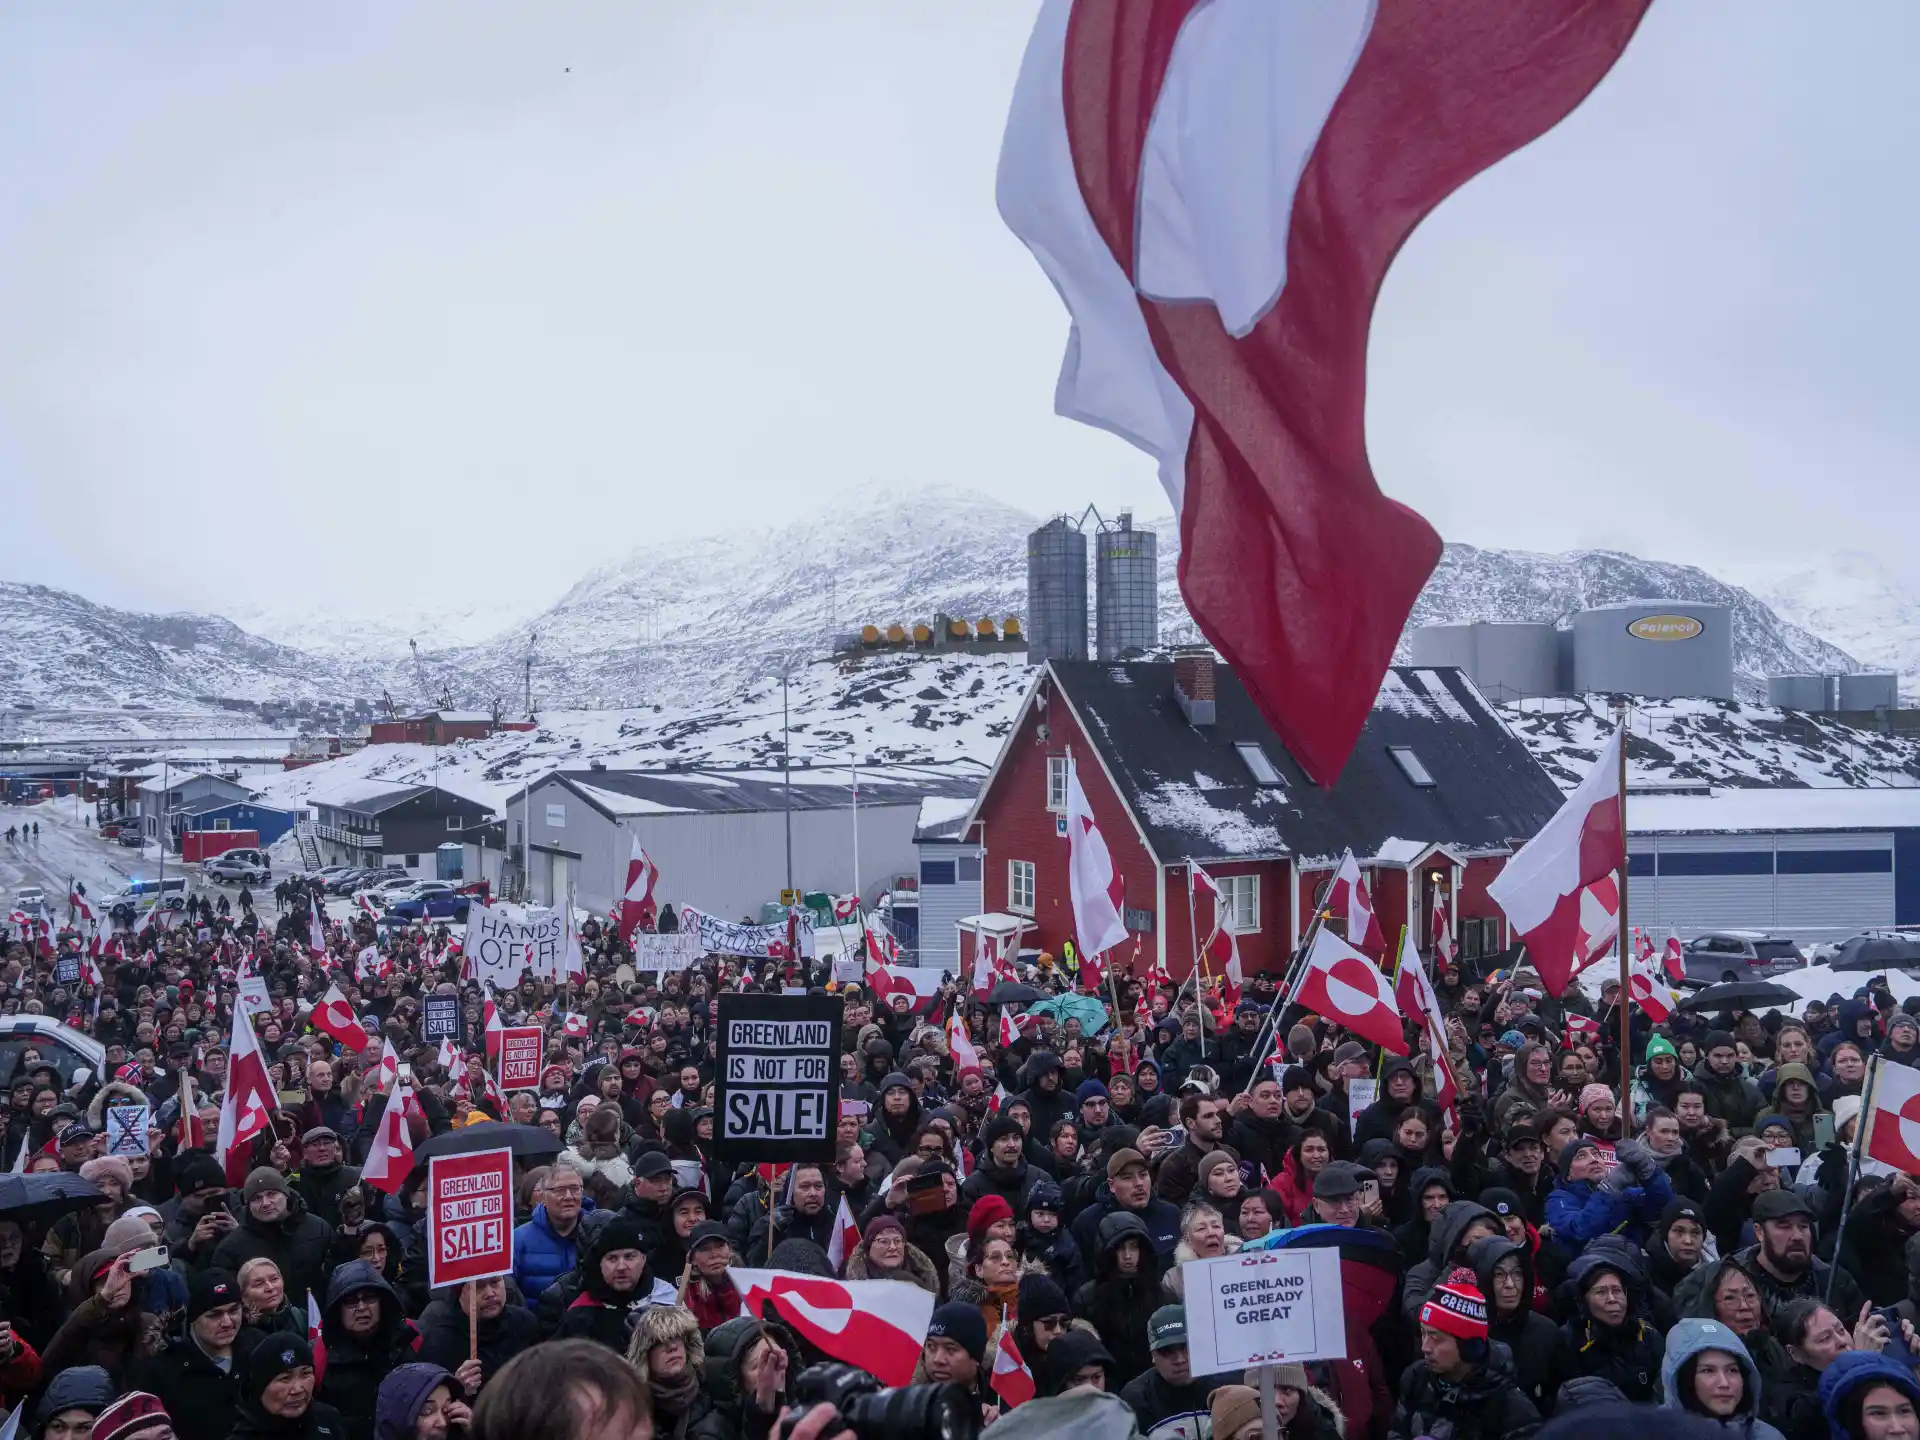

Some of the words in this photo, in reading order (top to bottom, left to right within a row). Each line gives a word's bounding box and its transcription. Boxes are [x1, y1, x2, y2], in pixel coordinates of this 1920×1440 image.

[481, 916, 560, 939] HANDS
[429, 1020, 455, 1033] SALE!
[731, 1023, 828, 1046] GREENLAND
[507, 1038, 537, 1048] GREENLAND
[506, 1051, 513, 1060] IS
[514, 1050, 525, 1059] NOT
[526, 1049, 537, 1058] FOR
[505, 1061, 536, 1078] SALE!
[729, 1057, 746, 1079] IS
[754, 1058, 787, 1080] NOT
[795, 1058, 826, 1080] FOR
[728, 1092, 825, 1136] SALE!
[443, 1173, 501, 1196] GREENLAND
[443, 1204, 453, 1220] IS
[457, 1200, 477, 1217] NOT
[482, 1197, 501, 1214] FOR
[444, 1220, 502, 1260] SALE!
[1220, 1276, 1304, 1295] GREENLAND
[1223, 1298, 1236, 1310] IS
[1239, 1290, 1303, 1308] ALREADY
[1236, 1306, 1291, 1325] GREAT
